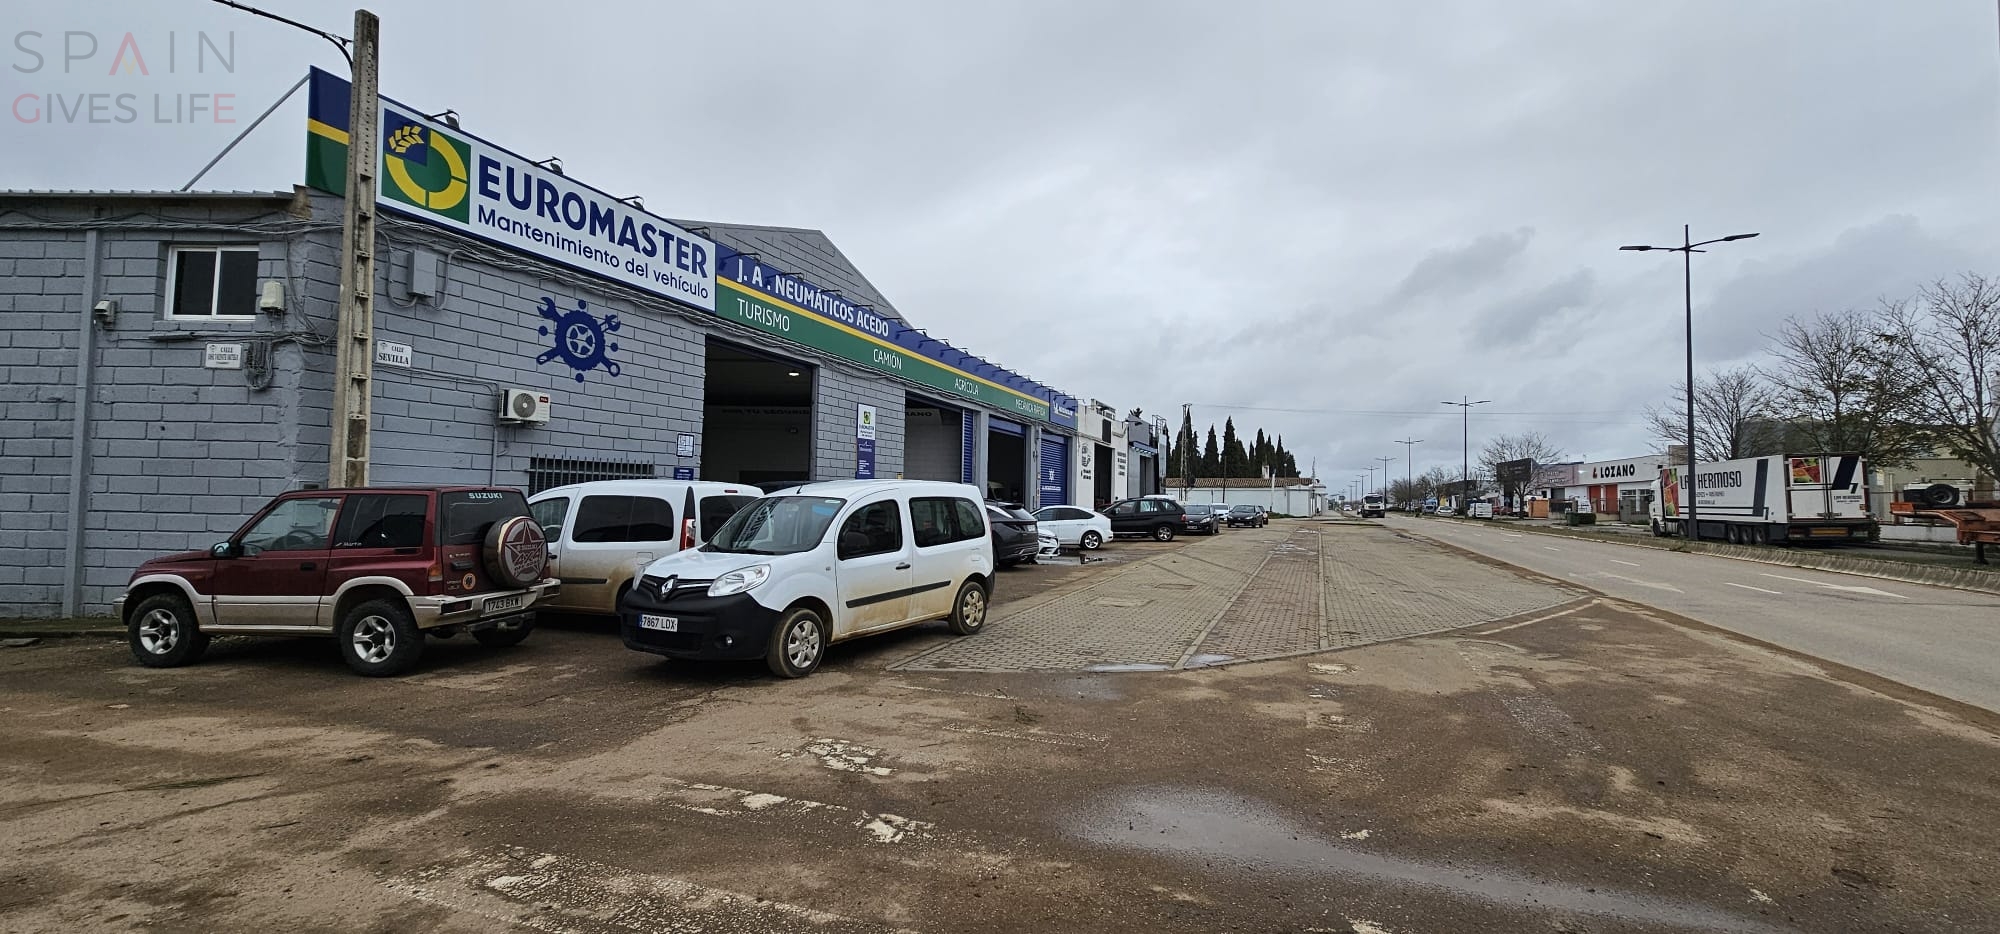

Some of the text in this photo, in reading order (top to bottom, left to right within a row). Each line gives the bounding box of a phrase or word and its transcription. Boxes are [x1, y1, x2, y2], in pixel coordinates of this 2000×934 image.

[479, 154, 708, 278] EUROMASTER
[479, 204, 708, 299] Mantenimiento del vehículo
[737, 298, 790, 331] TURISMO
[775, 274, 854, 324] NEUMÁTICOS
[856, 310, 889, 337] ACEDO
[378, 352, 409, 365] SEVILLA
[873, 349, 902, 370] CAMIÓN
[1600, 464, 1635, 478] LOZANO
[1698, 470, 1741, 489] HERMOSO
[487, 600, 504, 611] 1743
[643, 616, 675, 630] 7867 LDX
